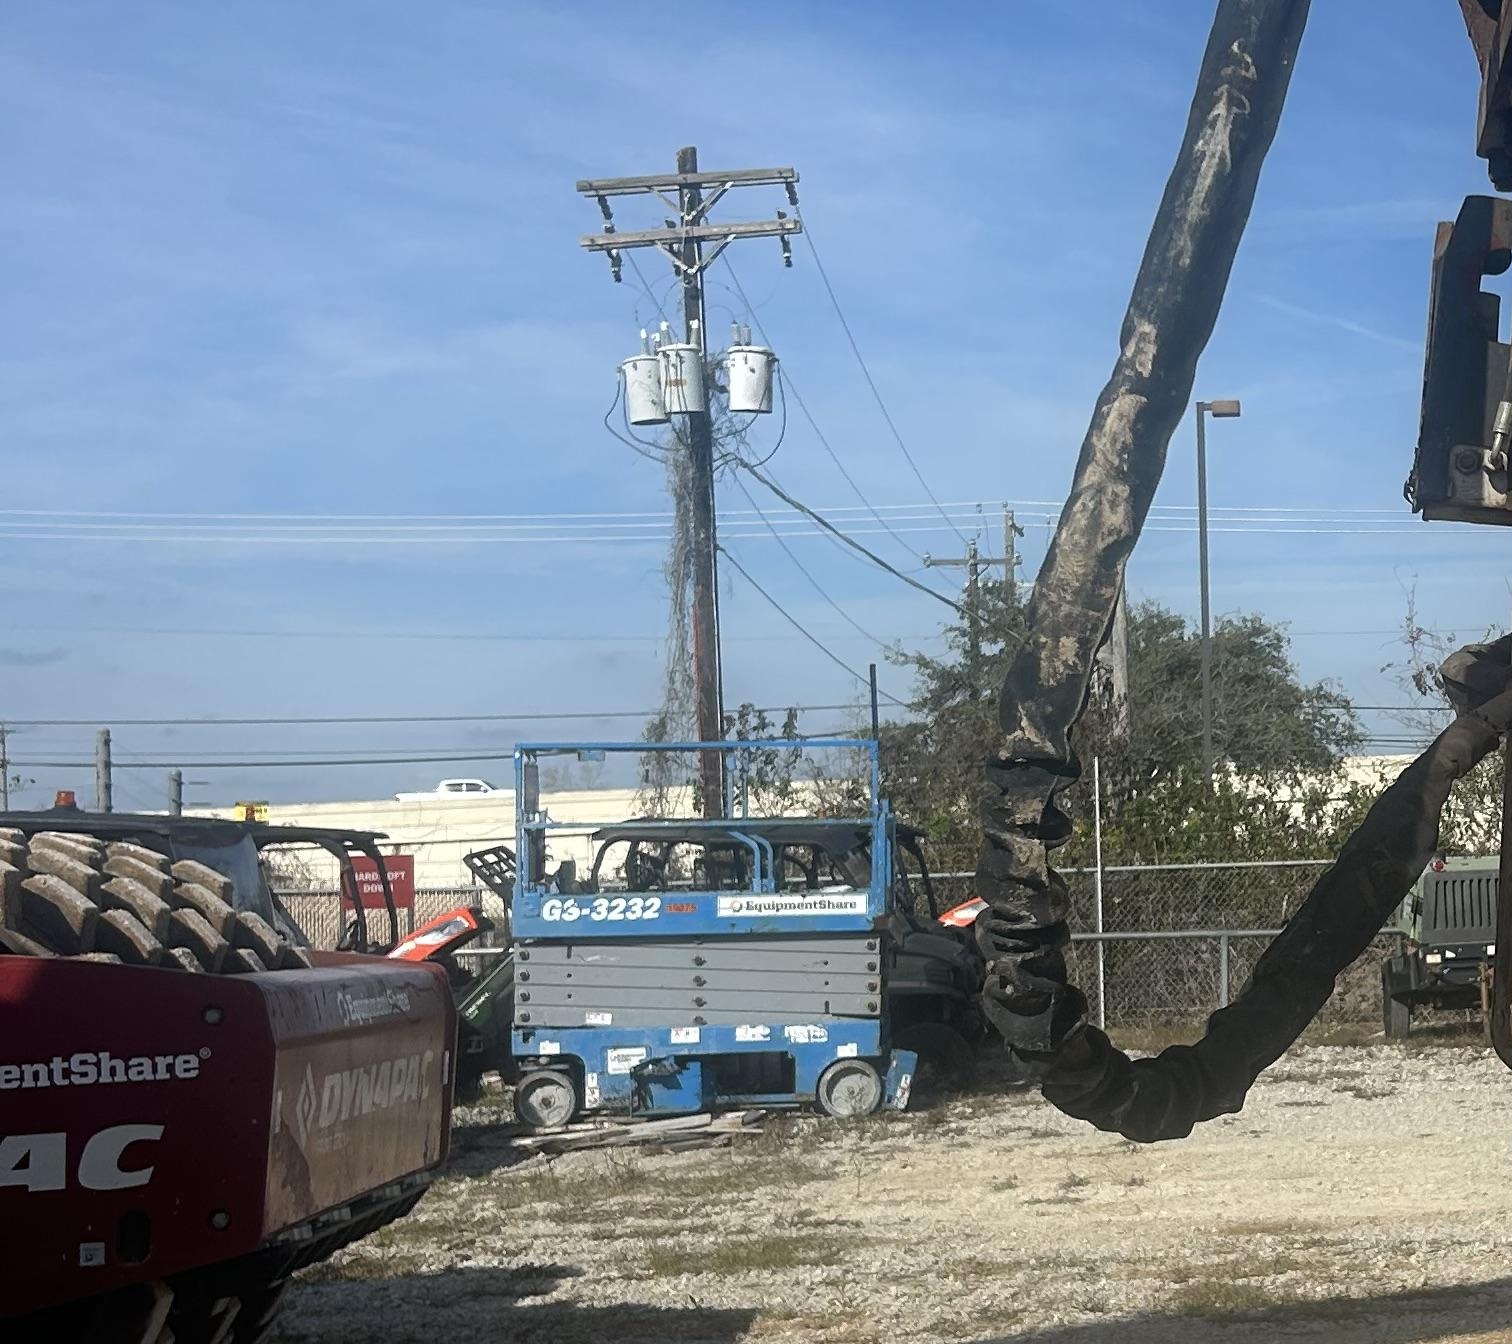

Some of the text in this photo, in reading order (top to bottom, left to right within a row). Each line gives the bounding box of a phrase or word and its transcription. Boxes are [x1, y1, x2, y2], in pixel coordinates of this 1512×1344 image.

[542, 897, 661, 922] GS-3232
[745, 899, 857, 913] EquipmentShare
[318, 1049, 434, 1129] DYNAPAC
